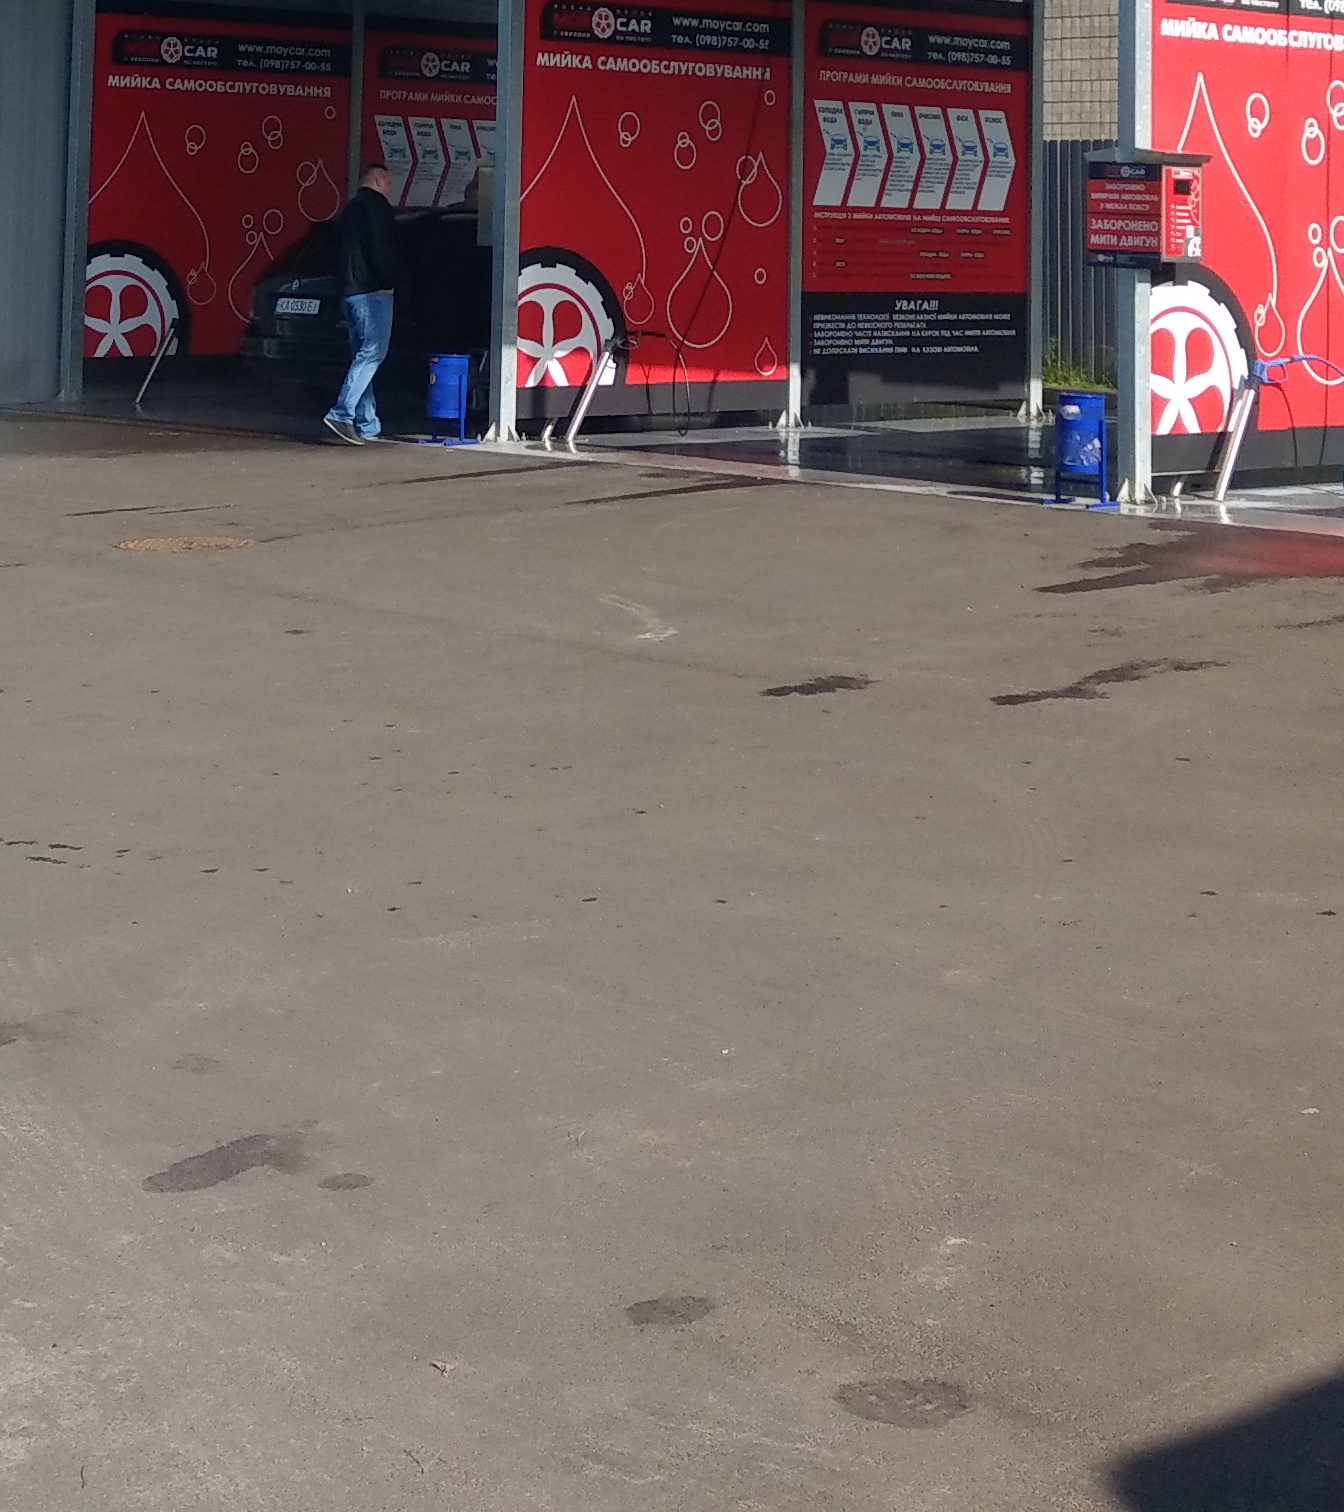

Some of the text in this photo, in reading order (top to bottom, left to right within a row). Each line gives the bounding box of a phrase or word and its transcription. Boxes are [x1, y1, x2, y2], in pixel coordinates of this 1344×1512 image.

[1299, 0, 1322, 11] тел.
[616, 17, 651, 33] CAR
[672, 16, 769, 33] www.moycar.com
[1161, 17, 1219, 41] МИЙКА
[237, 42, 331, 58] www.moycar.com
[671, 34, 769, 50] тел. (098)757-00-55
[881, 36, 912, 51] CAR
[927, 34, 1011, 50] www.moycar.com
[184, 45, 218, 58] CAR
[927, 50, 1012, 66] тел. (098)757-00-55
[259, 58, 331, 72] (098)757-00-55
[441, 60, 471, 73] CAR
[536, 50, 771, 80] МИЙКА САМООБСЛУГОВУВАННЯ
[108, 74, 332, 98] МИЙКА САМООБСЛУГОВУВАННЯ
[819, 69, 1012, 94] ПРОГРАМИ МИЙКИ САМООБСЛУГОВУВАННЯ
[380, 89, 428, 101] ПРОГРАМИ
[1090, 218, 1158, 232] ЗАБОРОНЕНО
[1090, 234, 1158, 248] МИТИ ДВИГУН
[894, 300, 939, 311] УВАГА!!!
